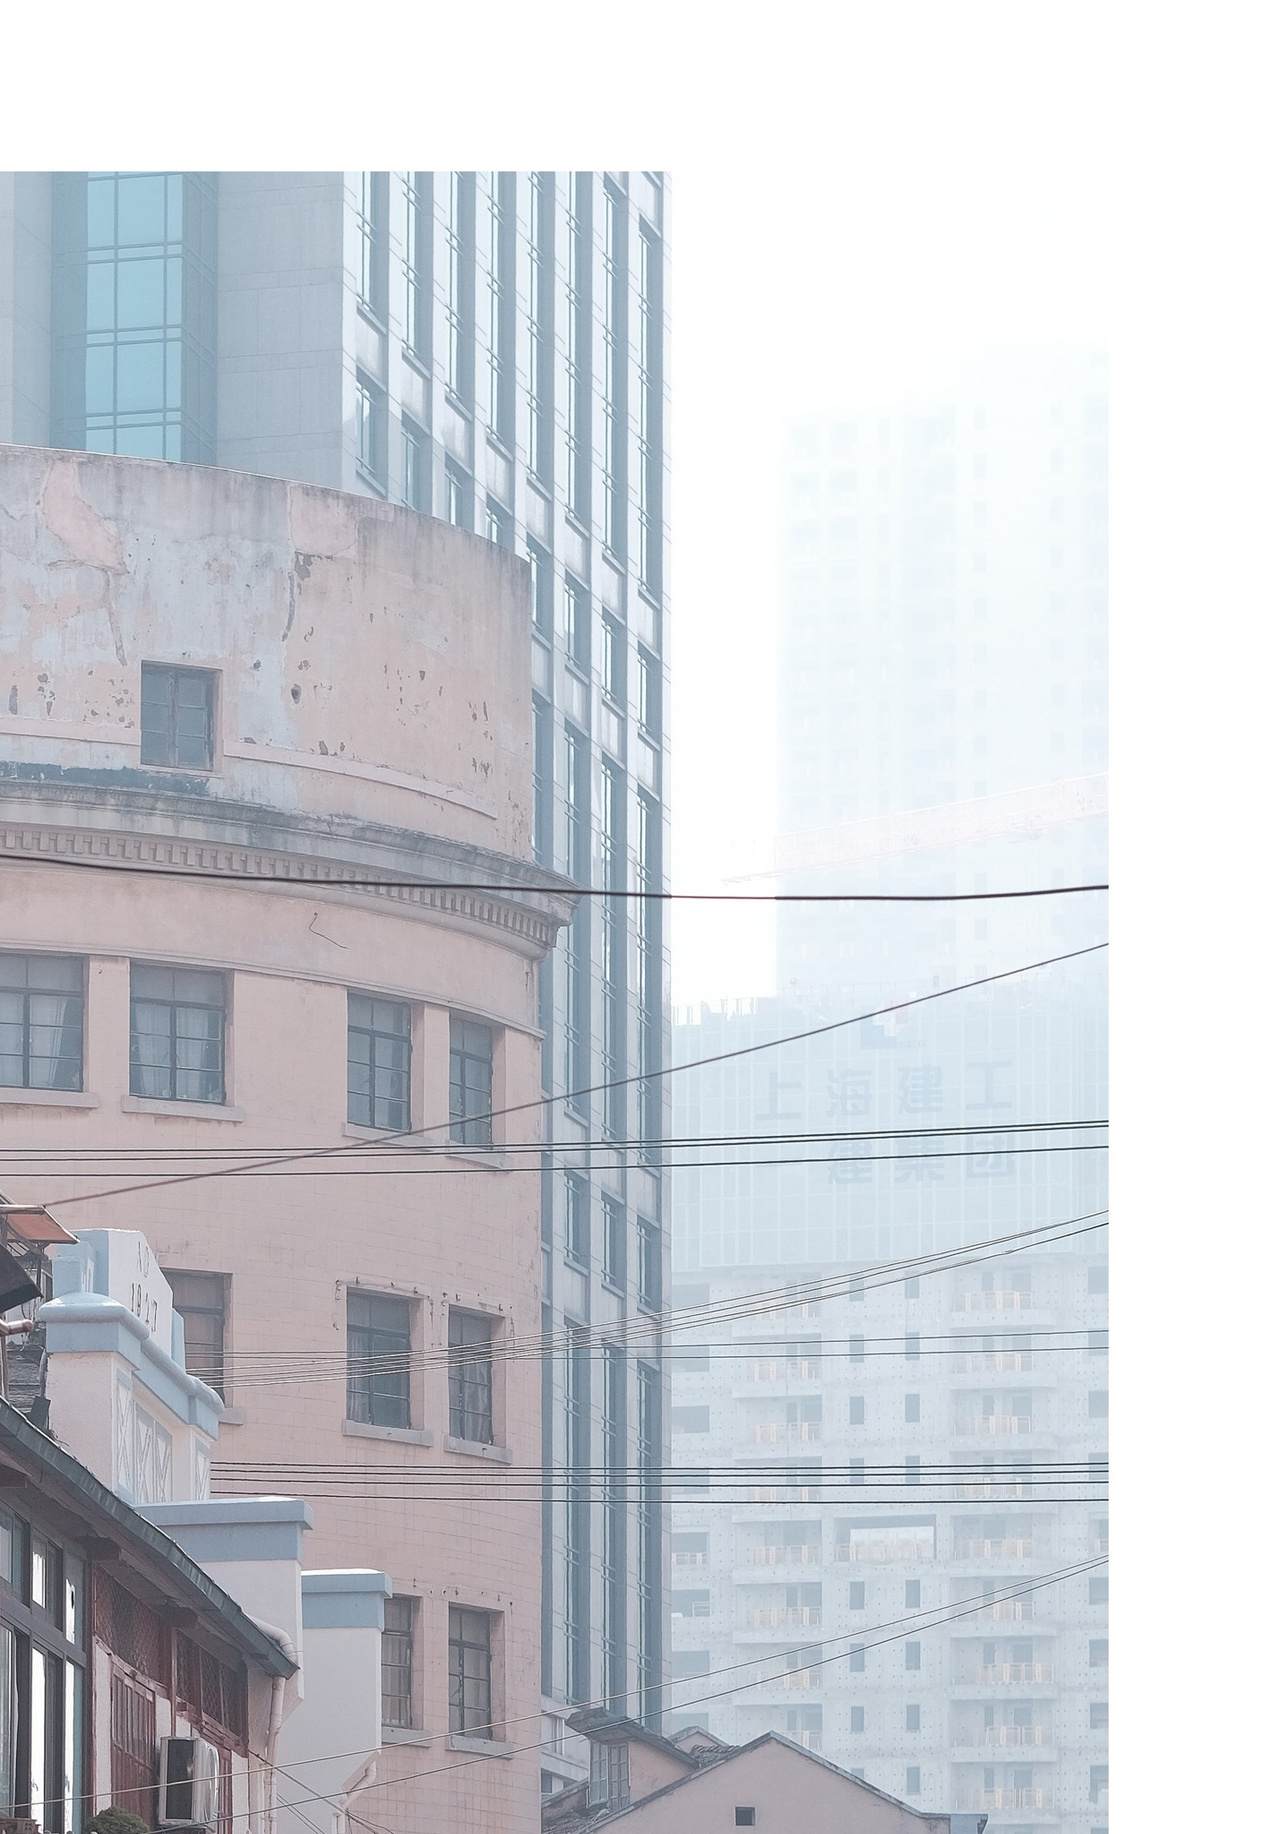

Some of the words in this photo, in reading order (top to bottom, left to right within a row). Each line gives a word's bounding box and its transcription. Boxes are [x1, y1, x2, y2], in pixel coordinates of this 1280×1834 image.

[755, 1060, 1013, 1121] 上海建工
[756, 1132, 1016, 1184] 建集团
